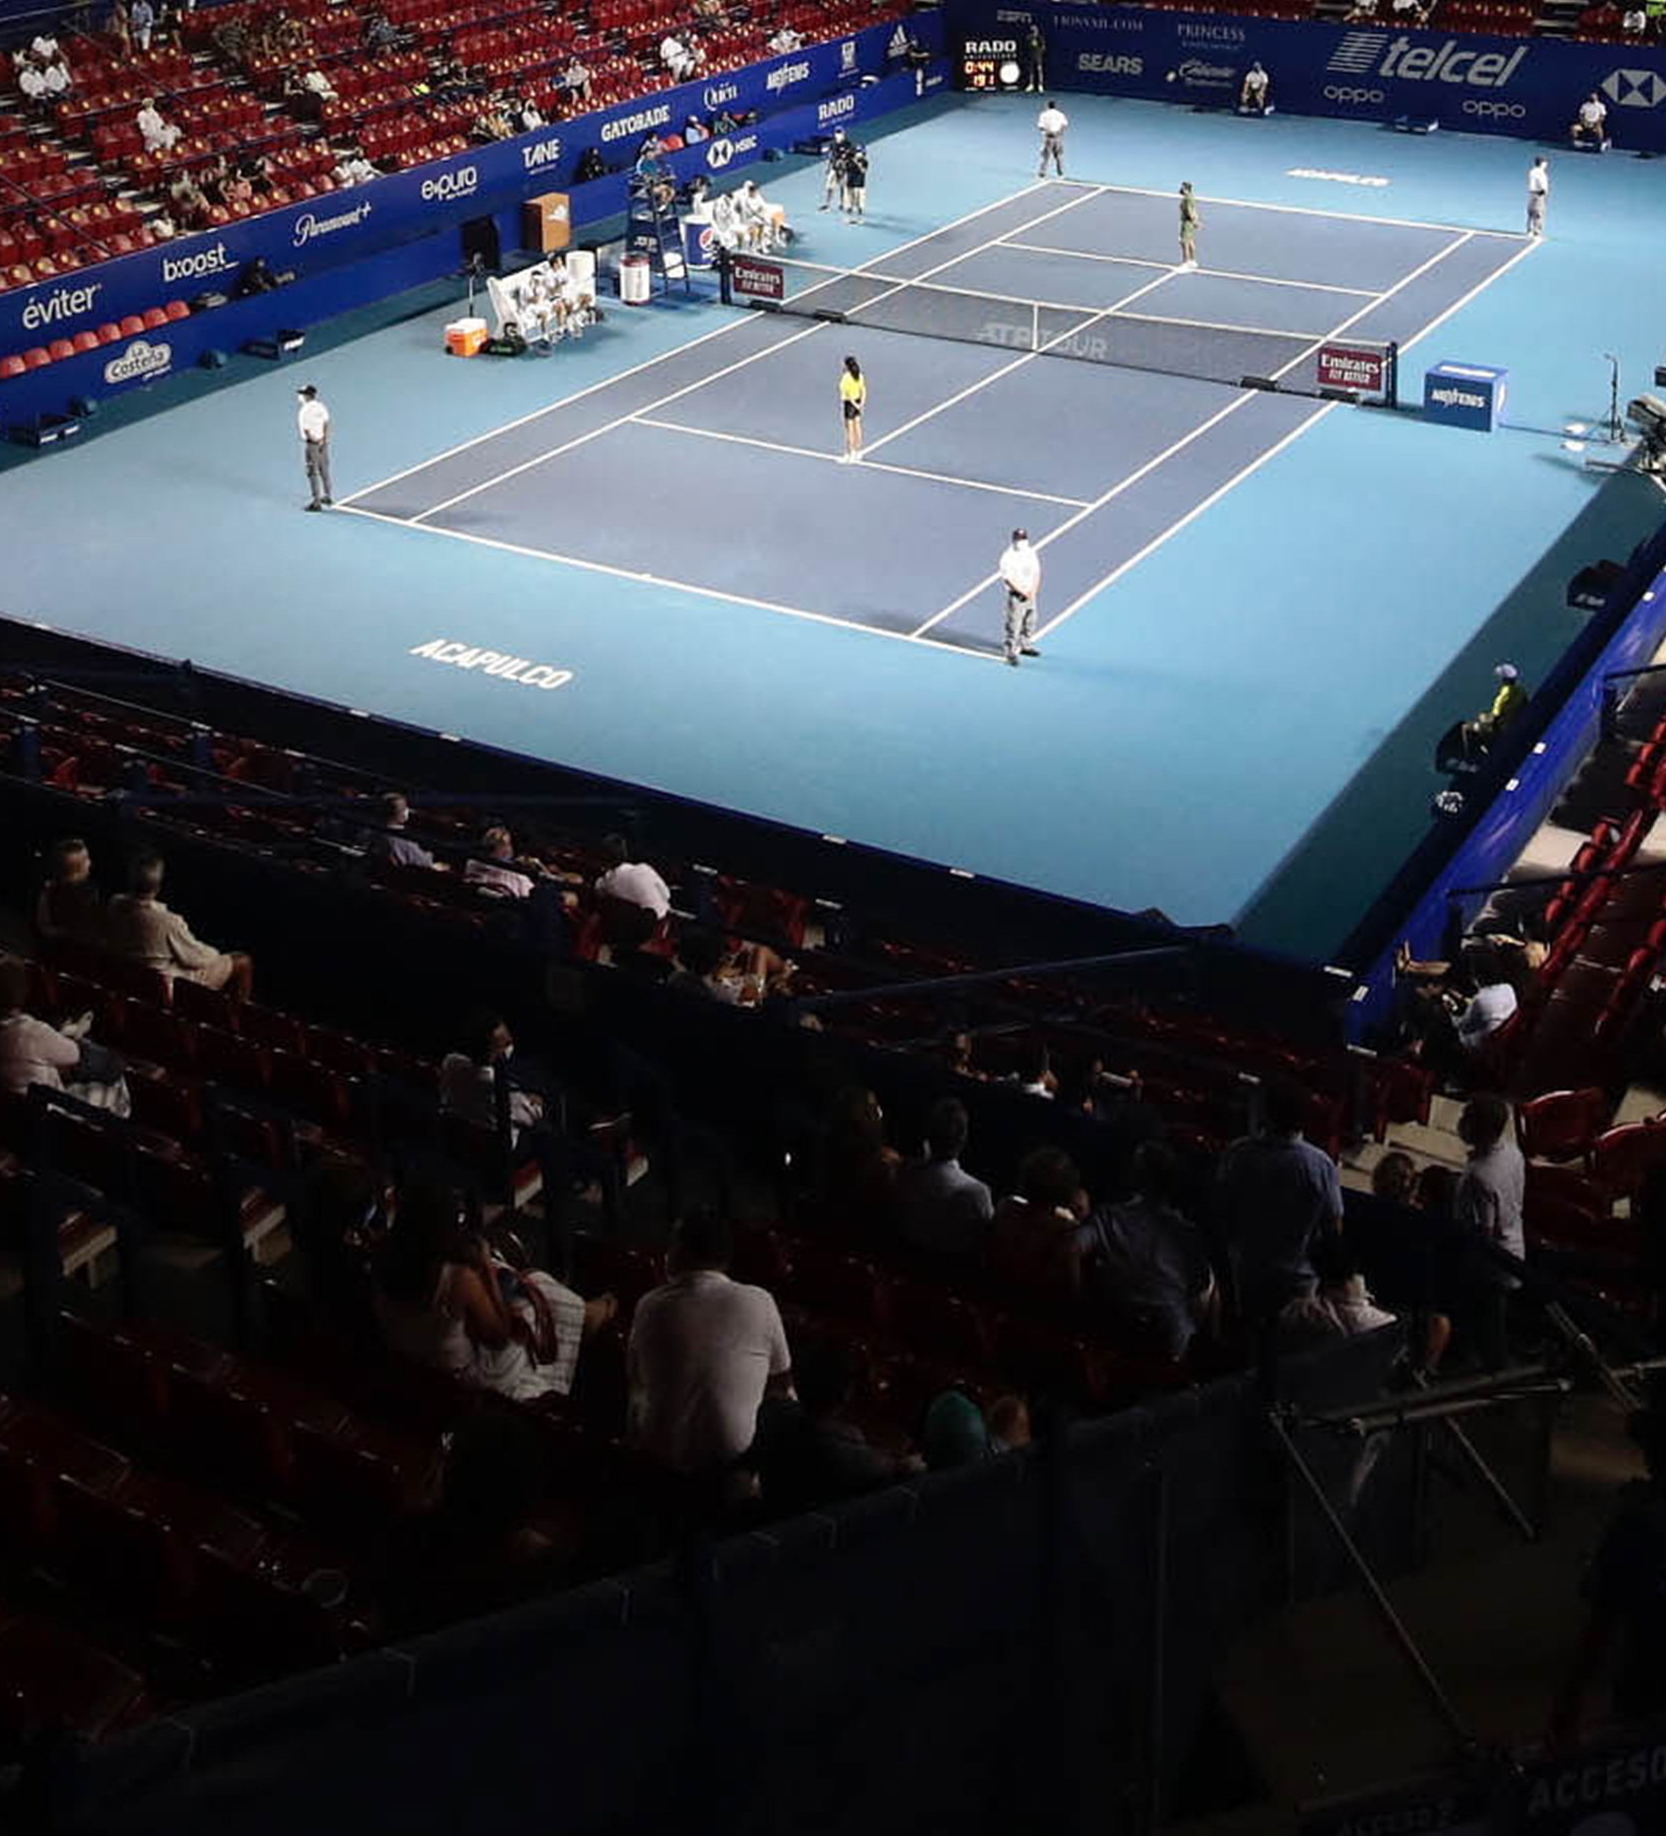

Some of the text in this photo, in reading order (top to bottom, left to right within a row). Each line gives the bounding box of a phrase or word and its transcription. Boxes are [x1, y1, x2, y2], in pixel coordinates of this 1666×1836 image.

[964, 39, 1018, 54] RADO
[1078, 52, 1144, 75] SEARS
[1378, 35, 1530, 87] telcel
[1323, 85, 1384, 104] oppo
[818, 95, 855, 121] RADO
[1462, 99, 1527, 119] oppo
[601, 105, 671, 142] GATORADE
[522, 138, 561, 169] TANE
[22, 285, 98, 329] éviter
[1321, 352, 1380, 374] Emirates
[409, 639, 574, 689] ACAPULCO
